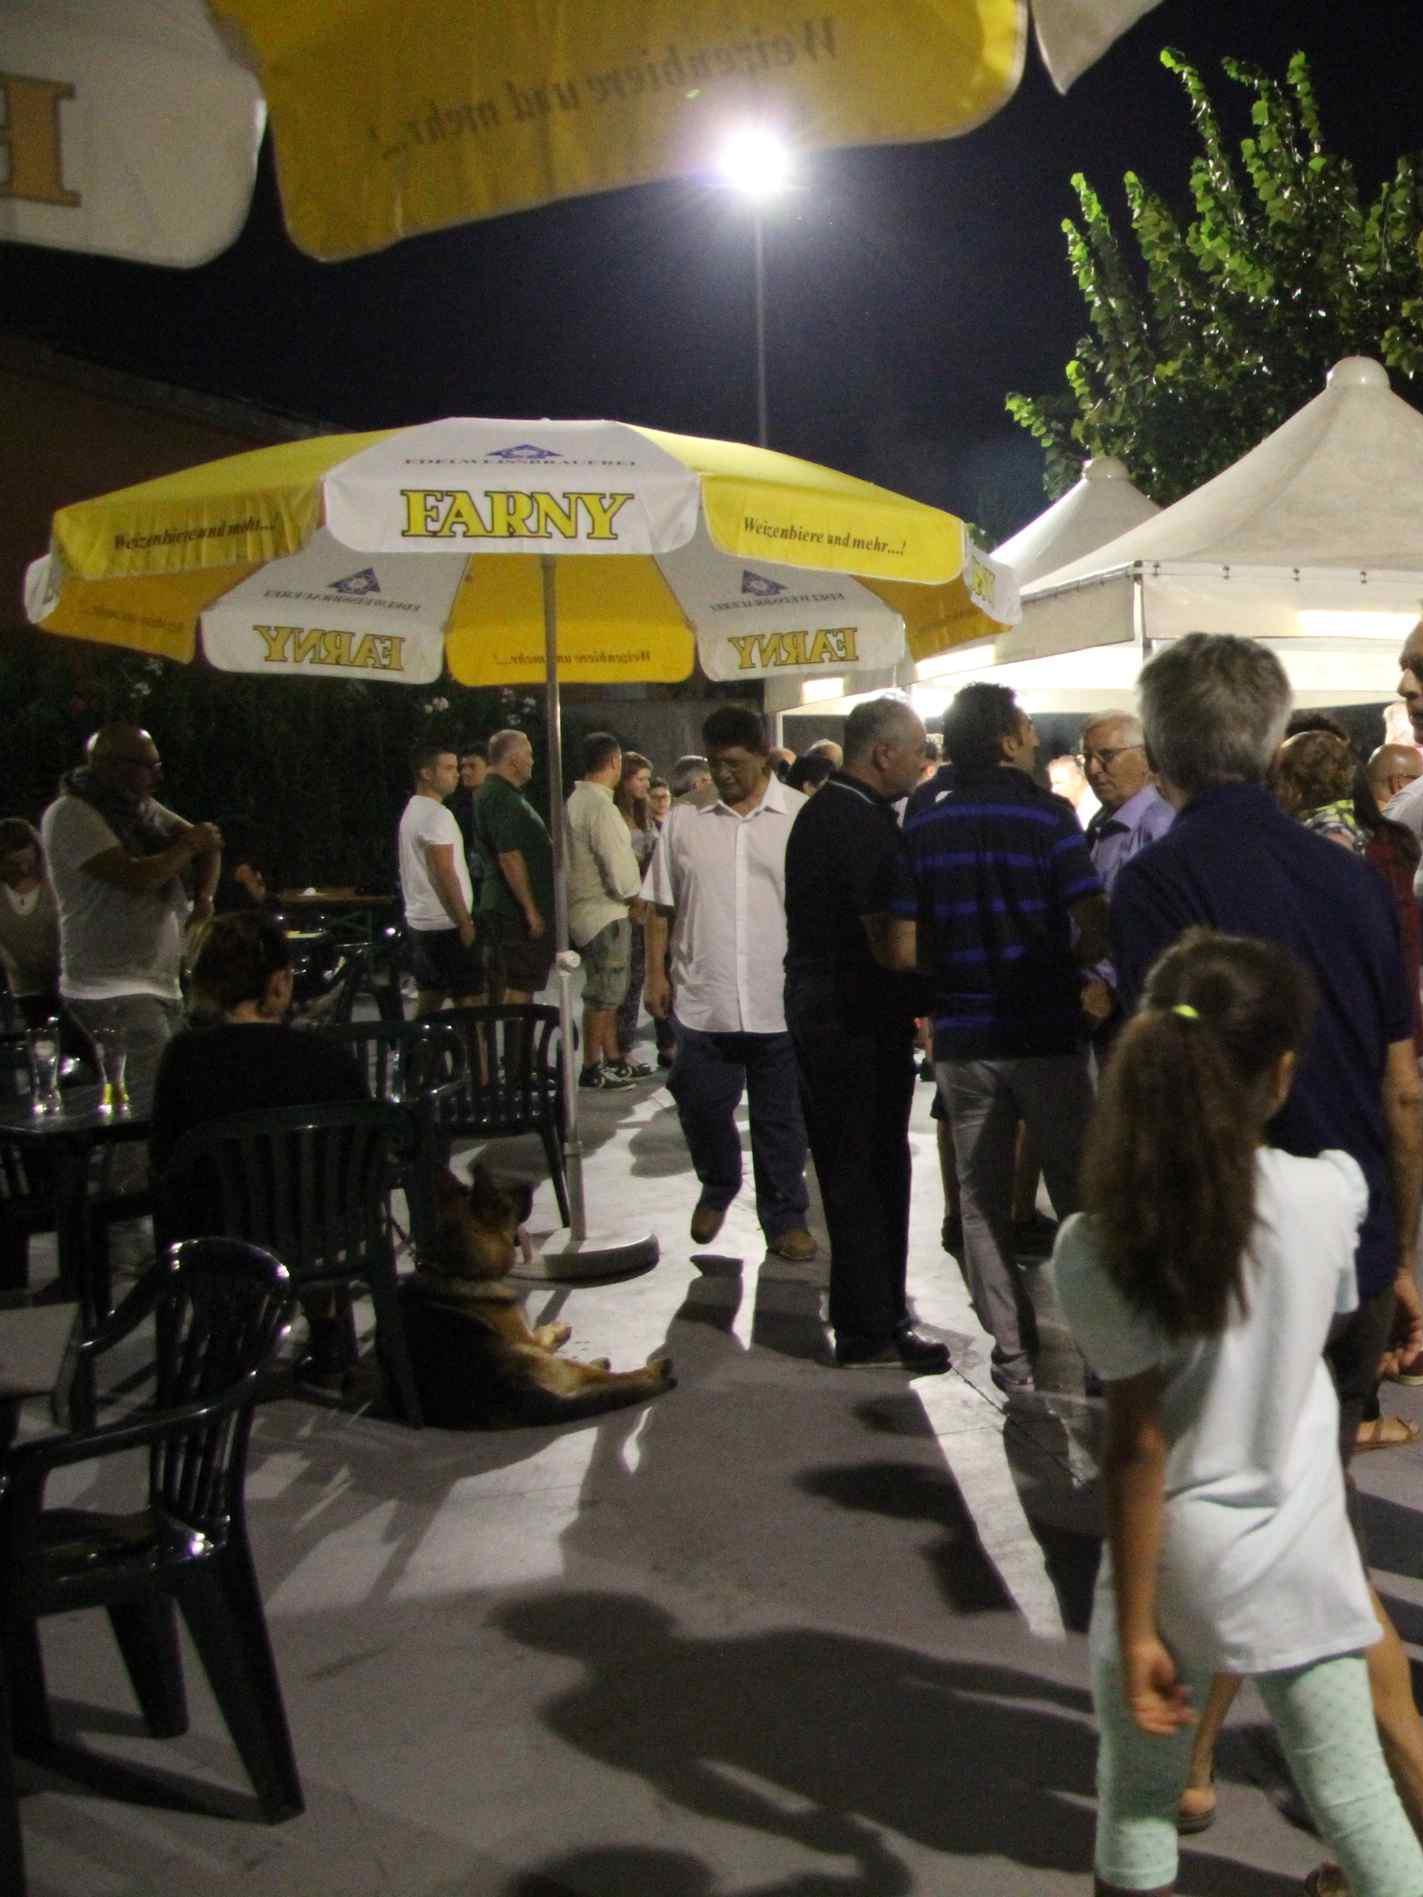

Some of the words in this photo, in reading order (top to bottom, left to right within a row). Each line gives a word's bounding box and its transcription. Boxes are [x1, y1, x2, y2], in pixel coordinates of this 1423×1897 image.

[399, 489, 636, 540] FARNY
[743, 515, 824, 545] Weizenbiere
[827, 532, 851, 548] und
